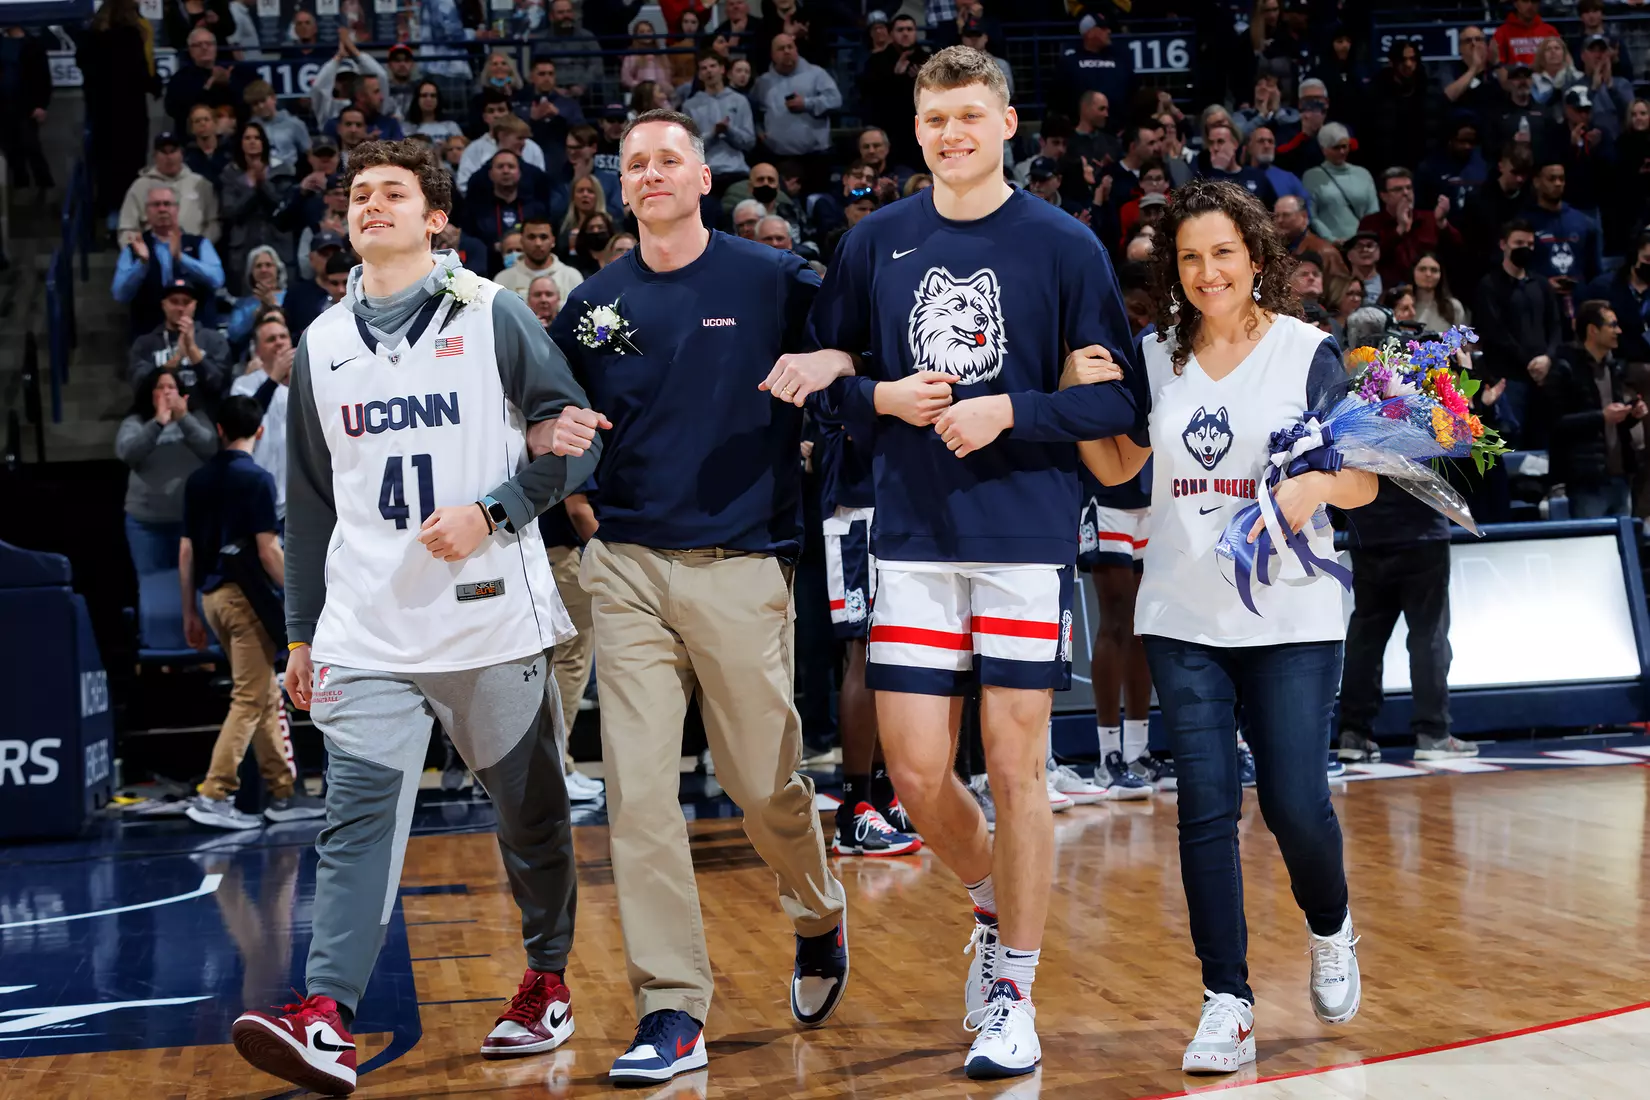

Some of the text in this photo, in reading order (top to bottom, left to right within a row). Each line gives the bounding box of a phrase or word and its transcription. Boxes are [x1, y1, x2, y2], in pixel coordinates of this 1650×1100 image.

[1128, 39, 1190, 69] 116
[257, 64, 321, 96] 116
[702, 317, 736, 327] UCONN
[341, 391, 461, 438] UCONN
[378, 453, 435, 531] 41
[1171, 478, 1257, 499] CONN HUSKIES
[0, 737, 61, 786] RS
